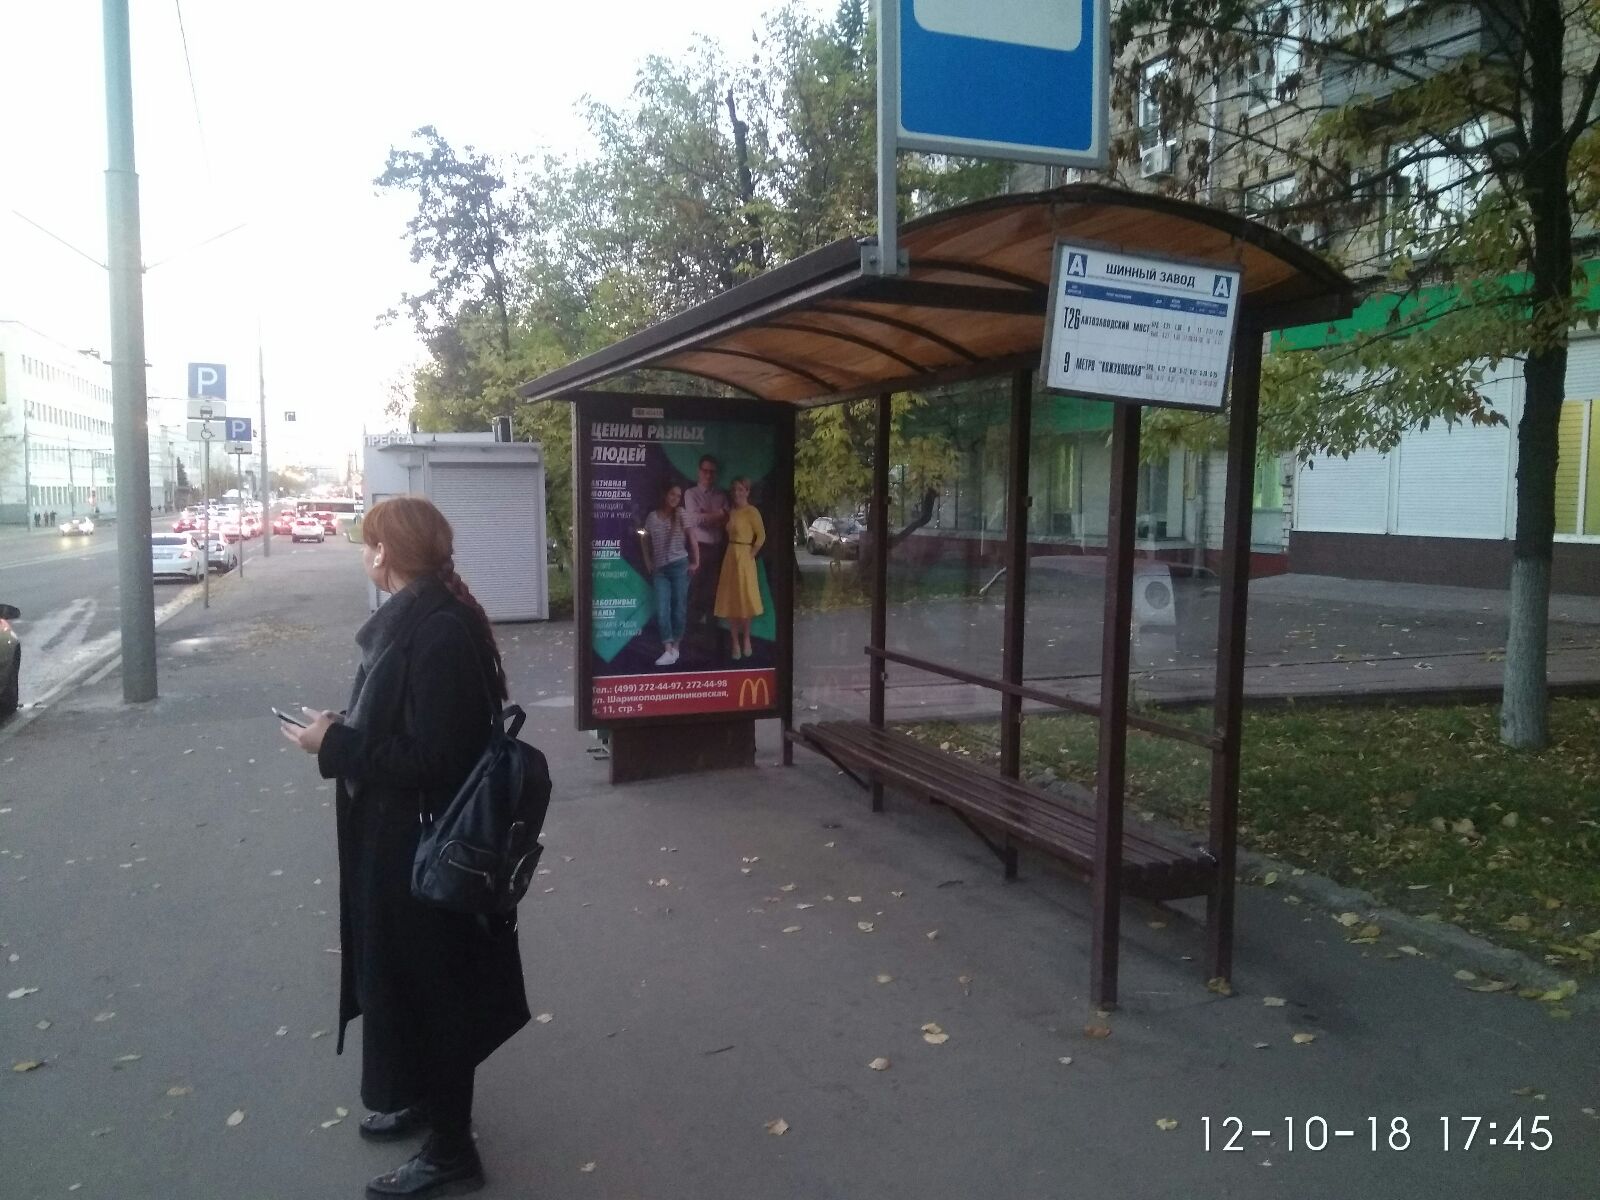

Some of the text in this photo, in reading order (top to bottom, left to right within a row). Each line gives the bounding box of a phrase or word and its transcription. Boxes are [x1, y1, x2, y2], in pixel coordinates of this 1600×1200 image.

[1106, 263, 1196, 289] ШИННЫЙ ЗАВОД
[1064, 306, 1081, 330] Т26
[1081, 315, 1130, 331] АВТОЗАВОДСКИЙ
[1063, 351, 1071, 373] 9
[1076, 357, 1096, 371] МЕТРО
[197, 366, 218, 395] P
[231, 419, 246, 439] P
[591, 422, 705, 440] ЦЕНИМ РАЗНЫХ
[591, 444, 647, 464] ЛЮДЕЙ
[613, 684, 637, 694] (499)
[638, 681, 684, 693] 272-44-97,
[686, 679, 728, 689] 272-44-98
[607, 690, 729, 704] Шарикоподшипниковская,
[602, 705, 615, 715] 11,
[618, 705, 635, 715] стр.
[637, 703, 644, 712] 5
